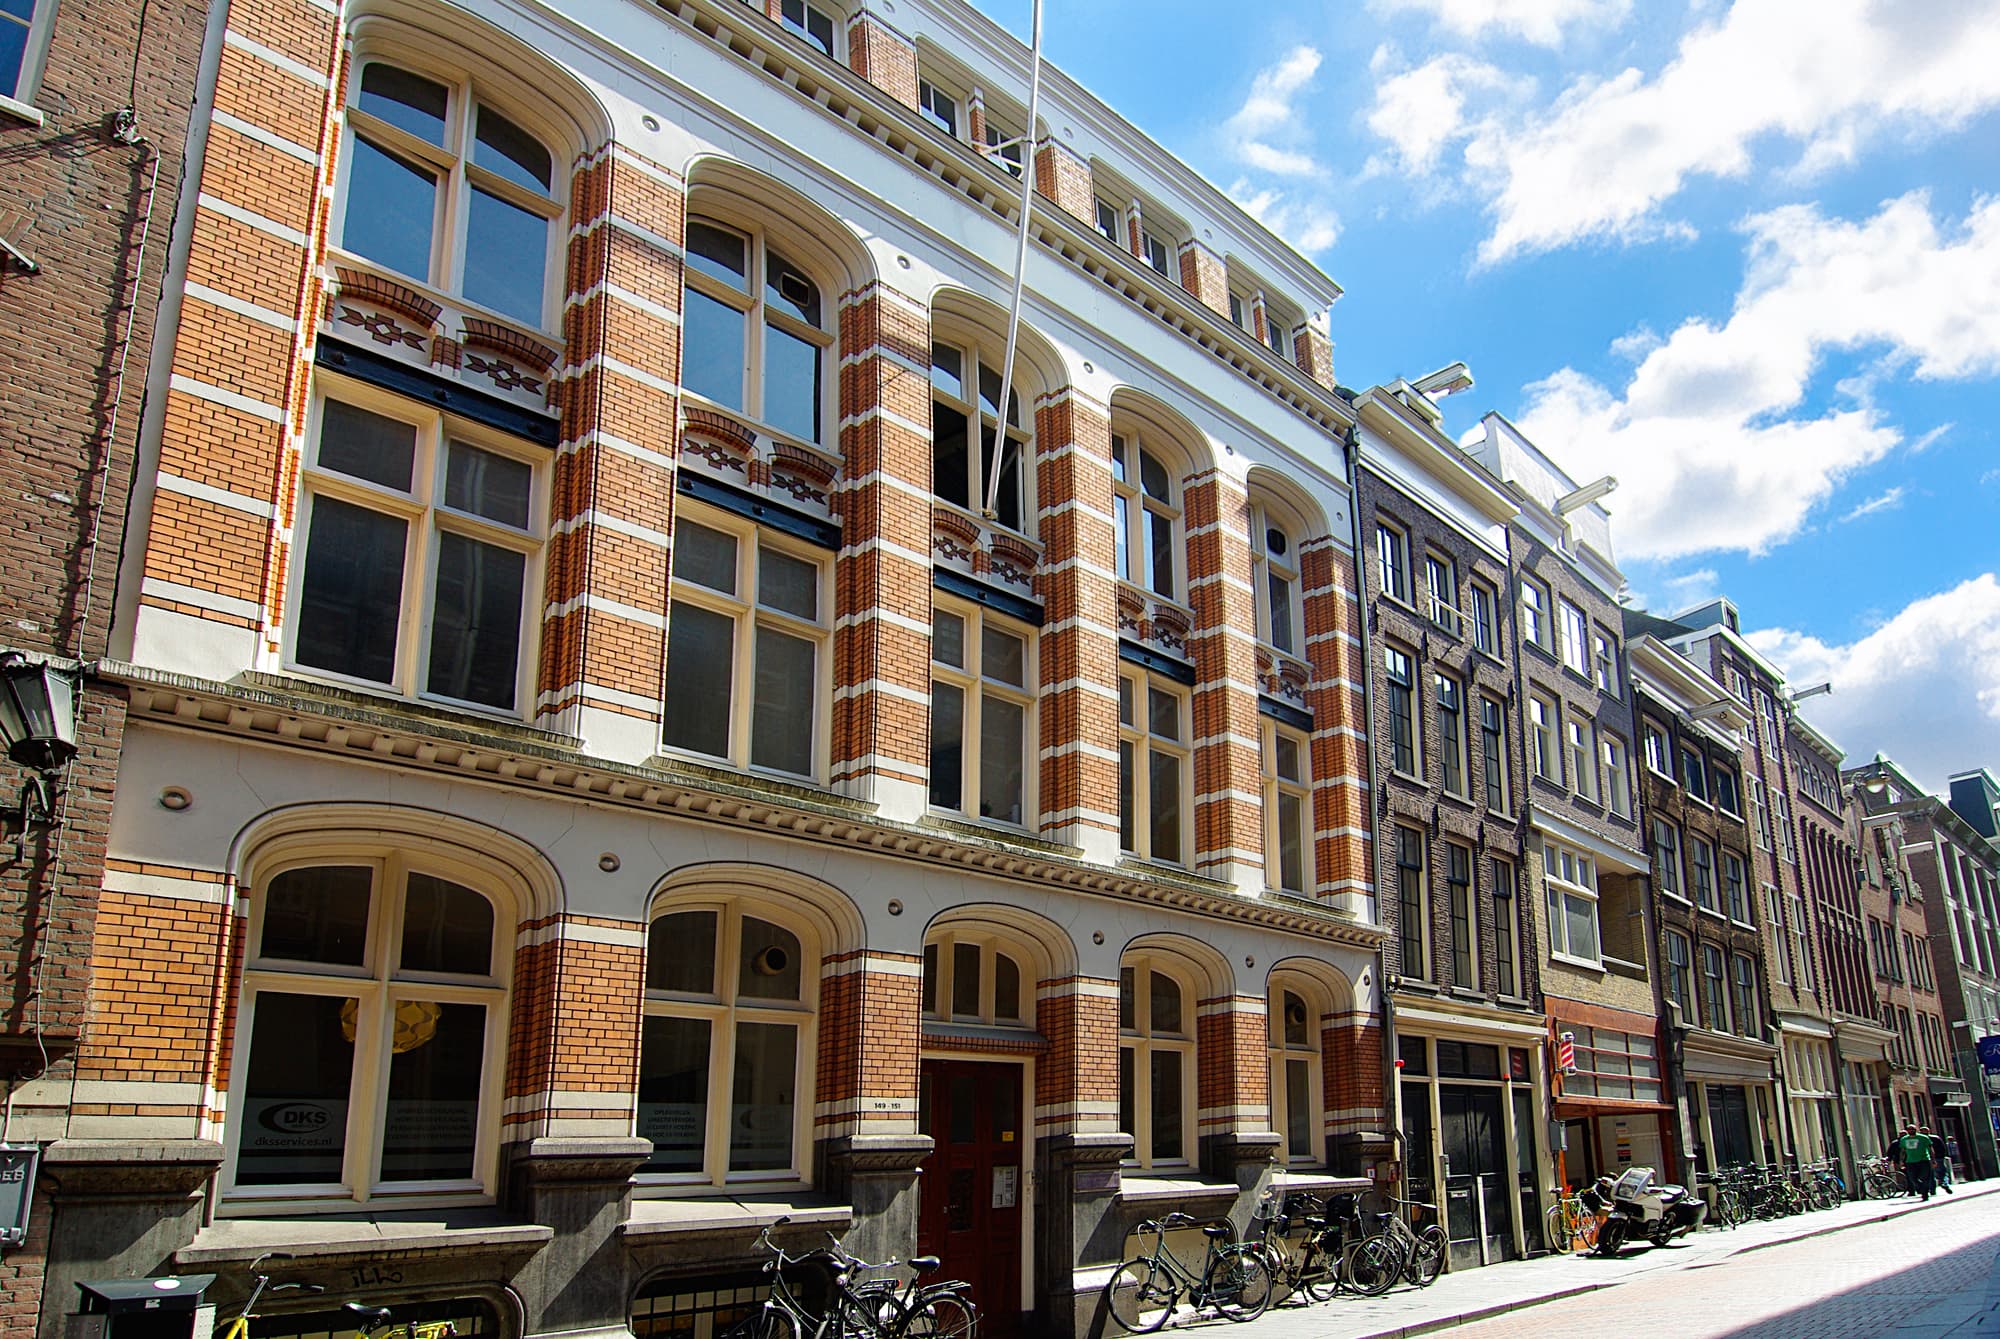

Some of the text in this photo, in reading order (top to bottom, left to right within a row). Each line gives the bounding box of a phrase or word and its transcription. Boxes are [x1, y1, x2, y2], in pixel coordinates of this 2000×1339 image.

[284, 1111, 327, 1124] DKS
[255, 1136, 332, 1146] dksservices.nl
[0, 1169, 25, 1181] EB
